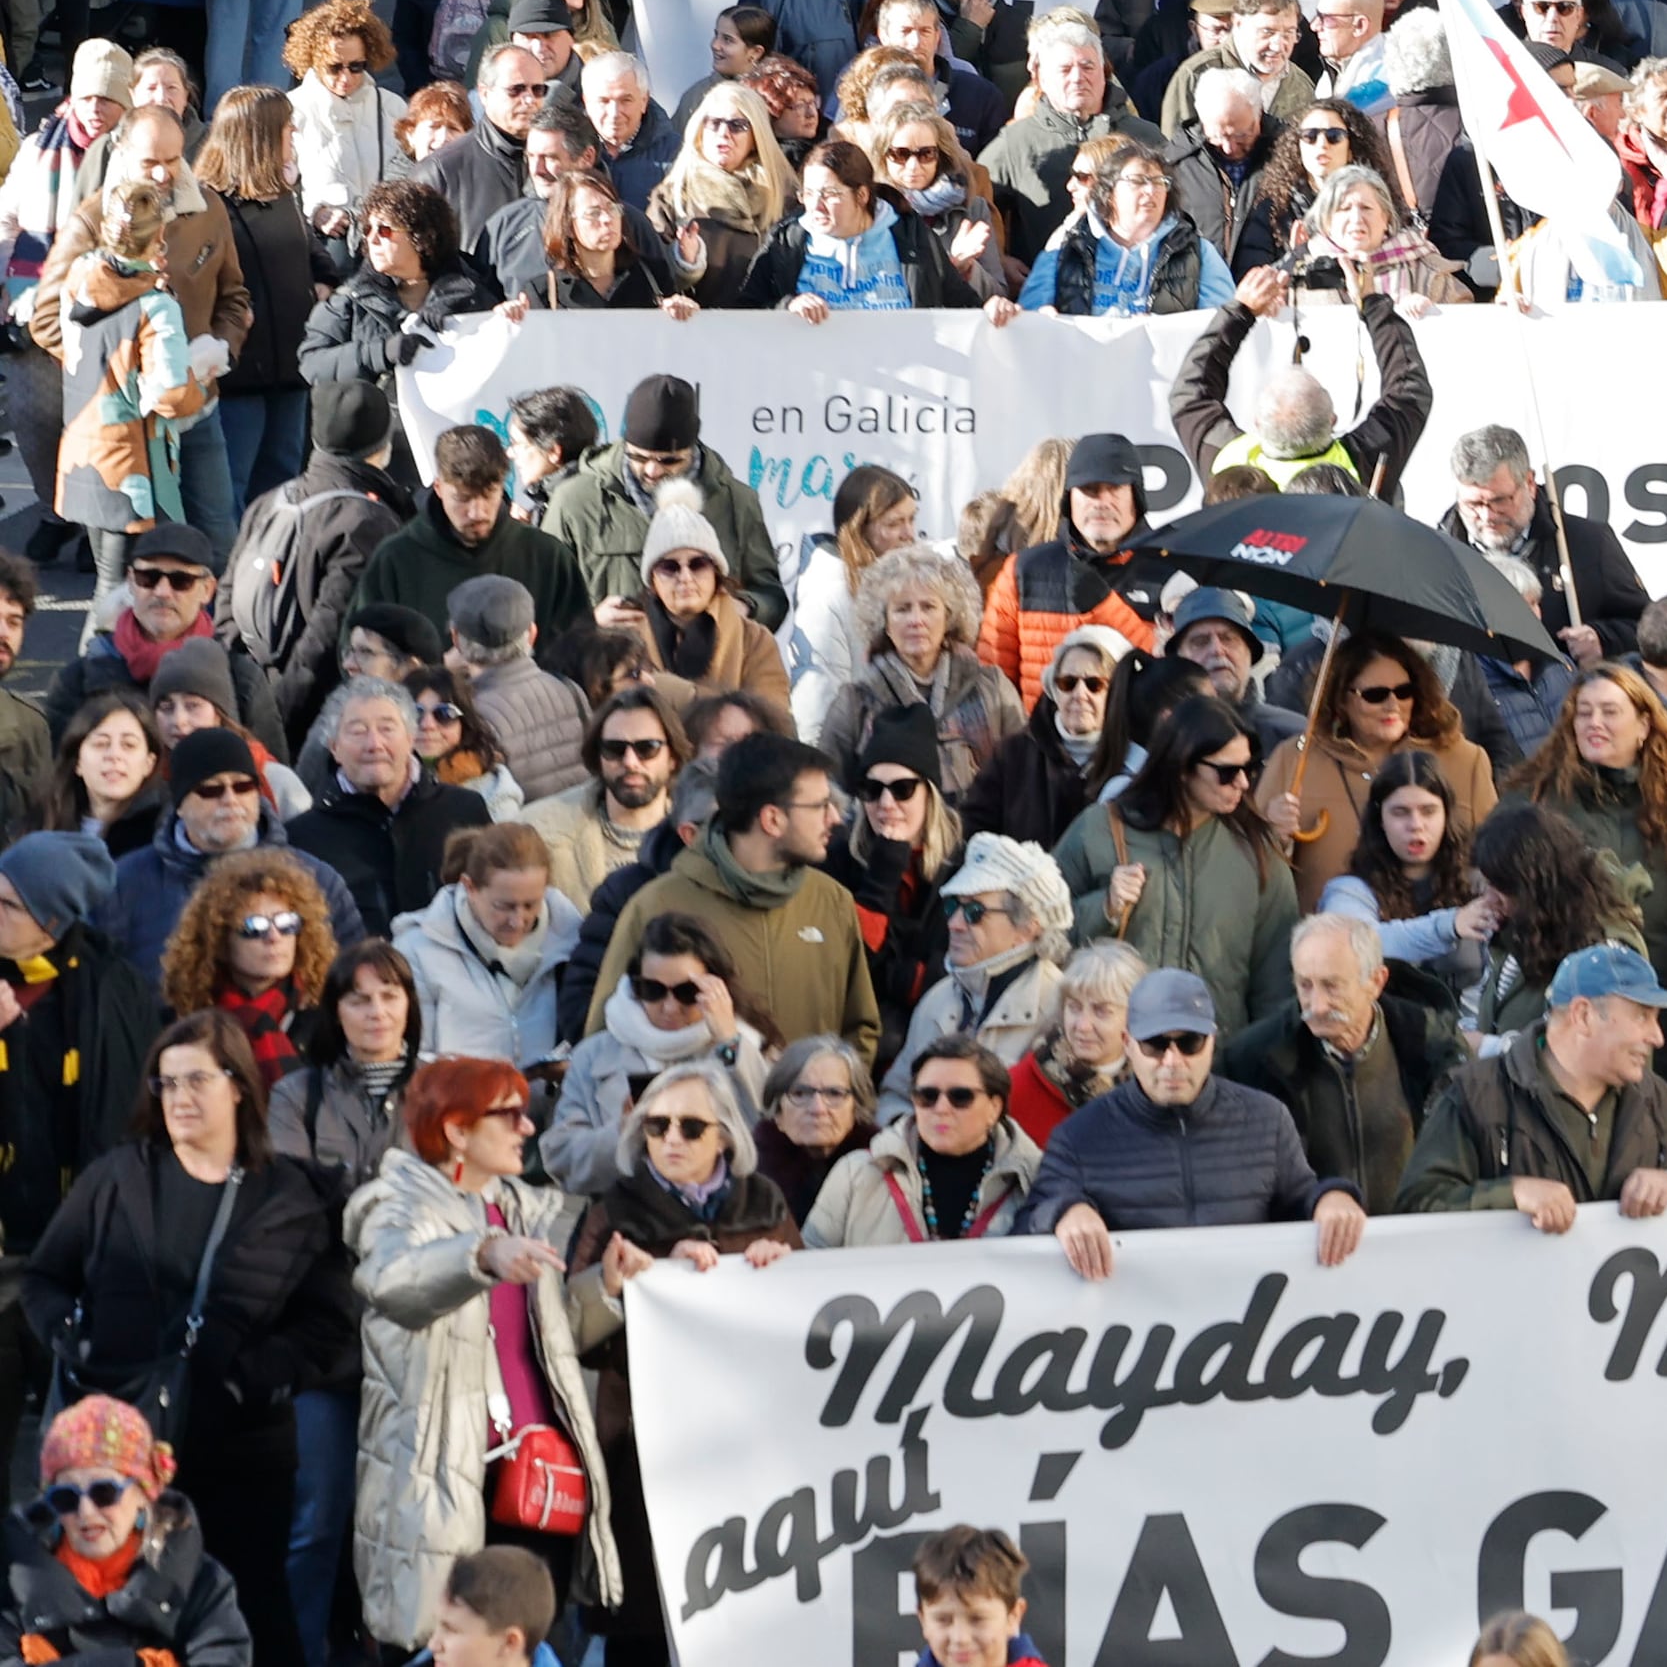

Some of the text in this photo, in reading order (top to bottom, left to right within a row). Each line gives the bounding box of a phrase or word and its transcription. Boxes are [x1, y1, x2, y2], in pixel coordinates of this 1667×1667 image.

[751, 394, 978, 435] en Galicia
[1230, 542, 1294, 565] NON
[1242, 528, 1308, 553] ALTRI
[804, 1272, 1471, 1450] Mayday,
[680, 1404, 942, 1622] aquí
